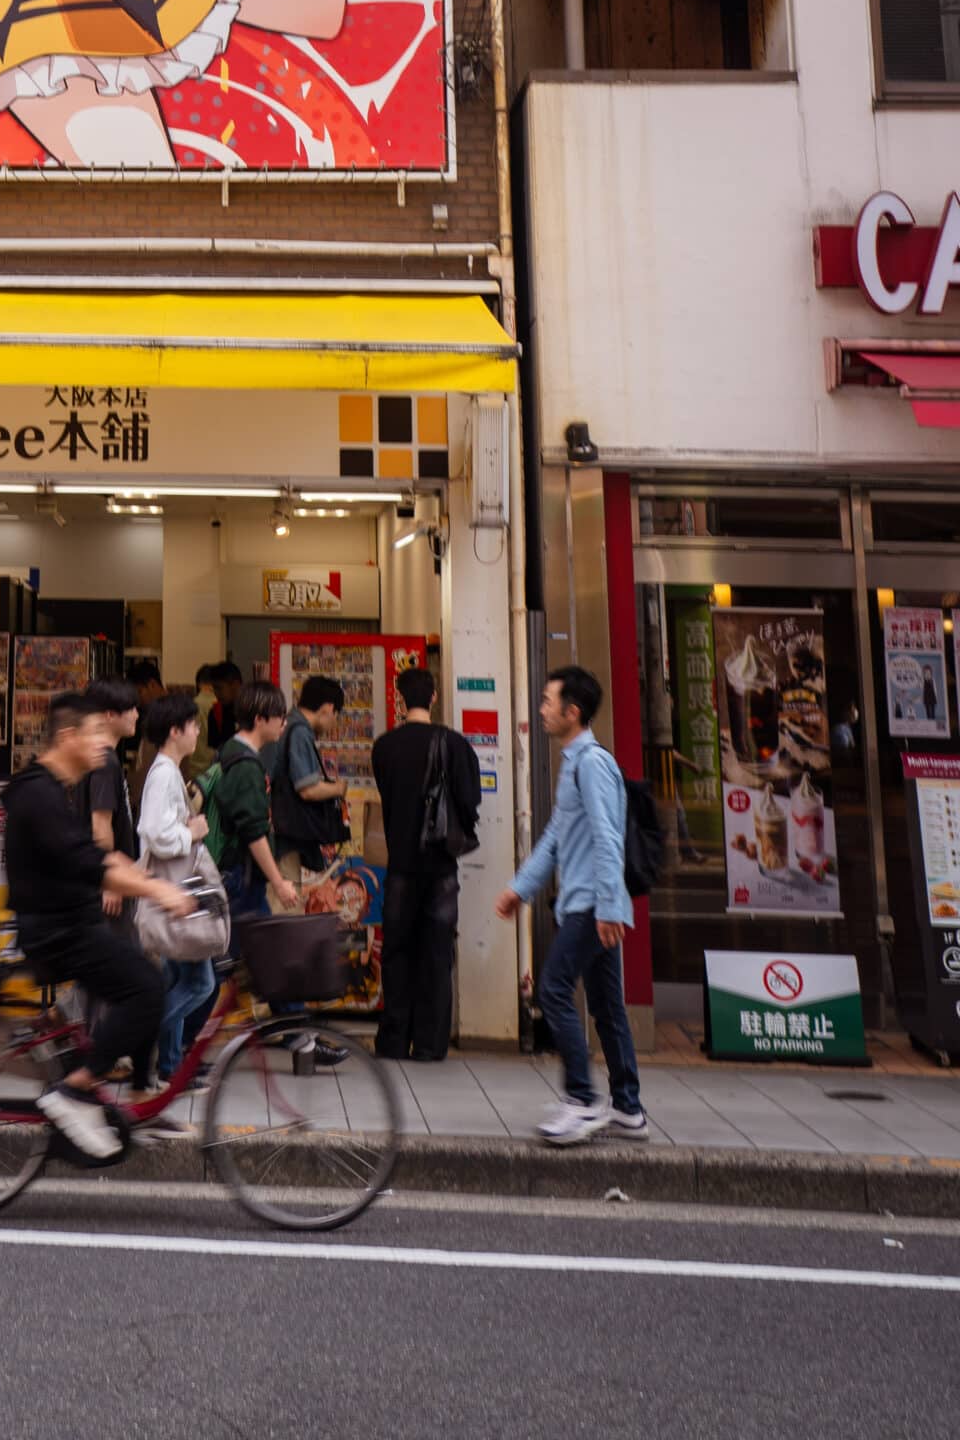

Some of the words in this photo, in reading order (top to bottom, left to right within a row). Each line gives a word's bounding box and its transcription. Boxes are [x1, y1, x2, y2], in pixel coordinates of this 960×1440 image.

[44, 385, 150, 408] 大阪本店
[740, 1010, 836, 1040] 駐輪禁止
[753, 1038, 772, 1051] NO
[773, 1039, 825, 1054] PARKING
